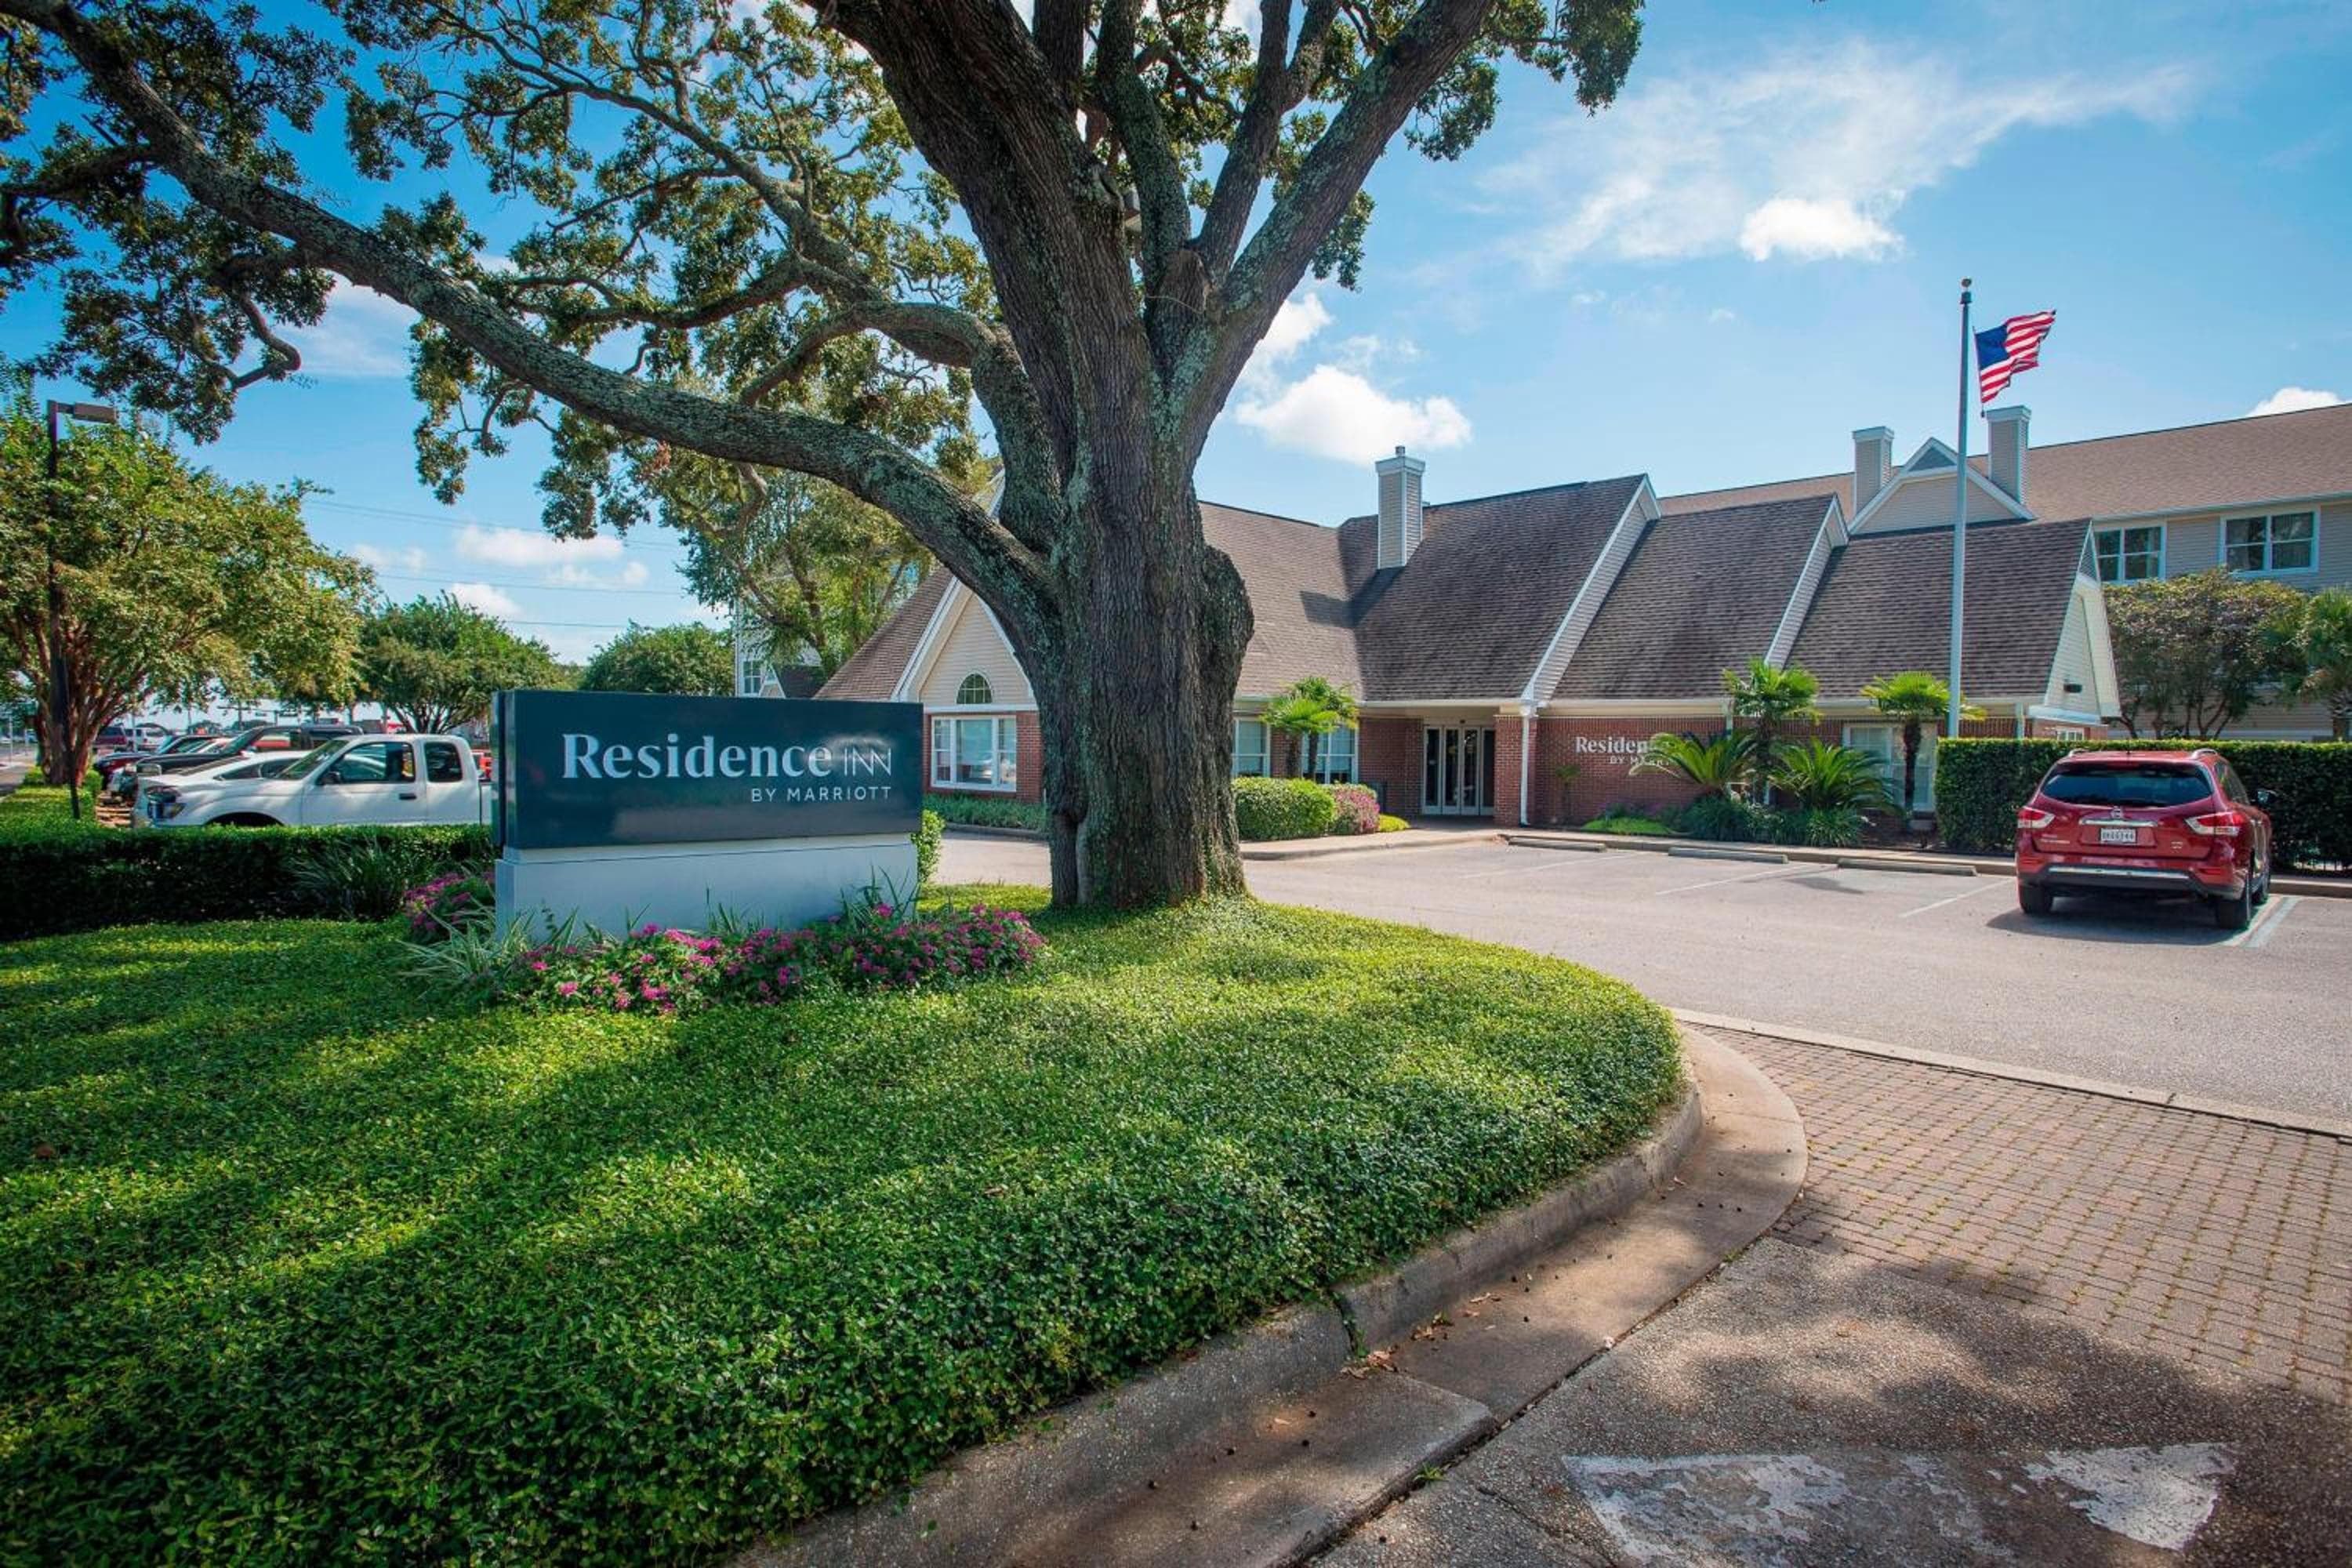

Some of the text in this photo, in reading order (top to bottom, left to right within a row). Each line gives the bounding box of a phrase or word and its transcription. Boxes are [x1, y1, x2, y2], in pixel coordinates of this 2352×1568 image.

[1575, 736, 1650, 753] Residen
[562, 733, 891, 778] Residence INN
[1609, 755, 1624, 764] BY
[751, 786, 891, 802] BY MARRIOTT
